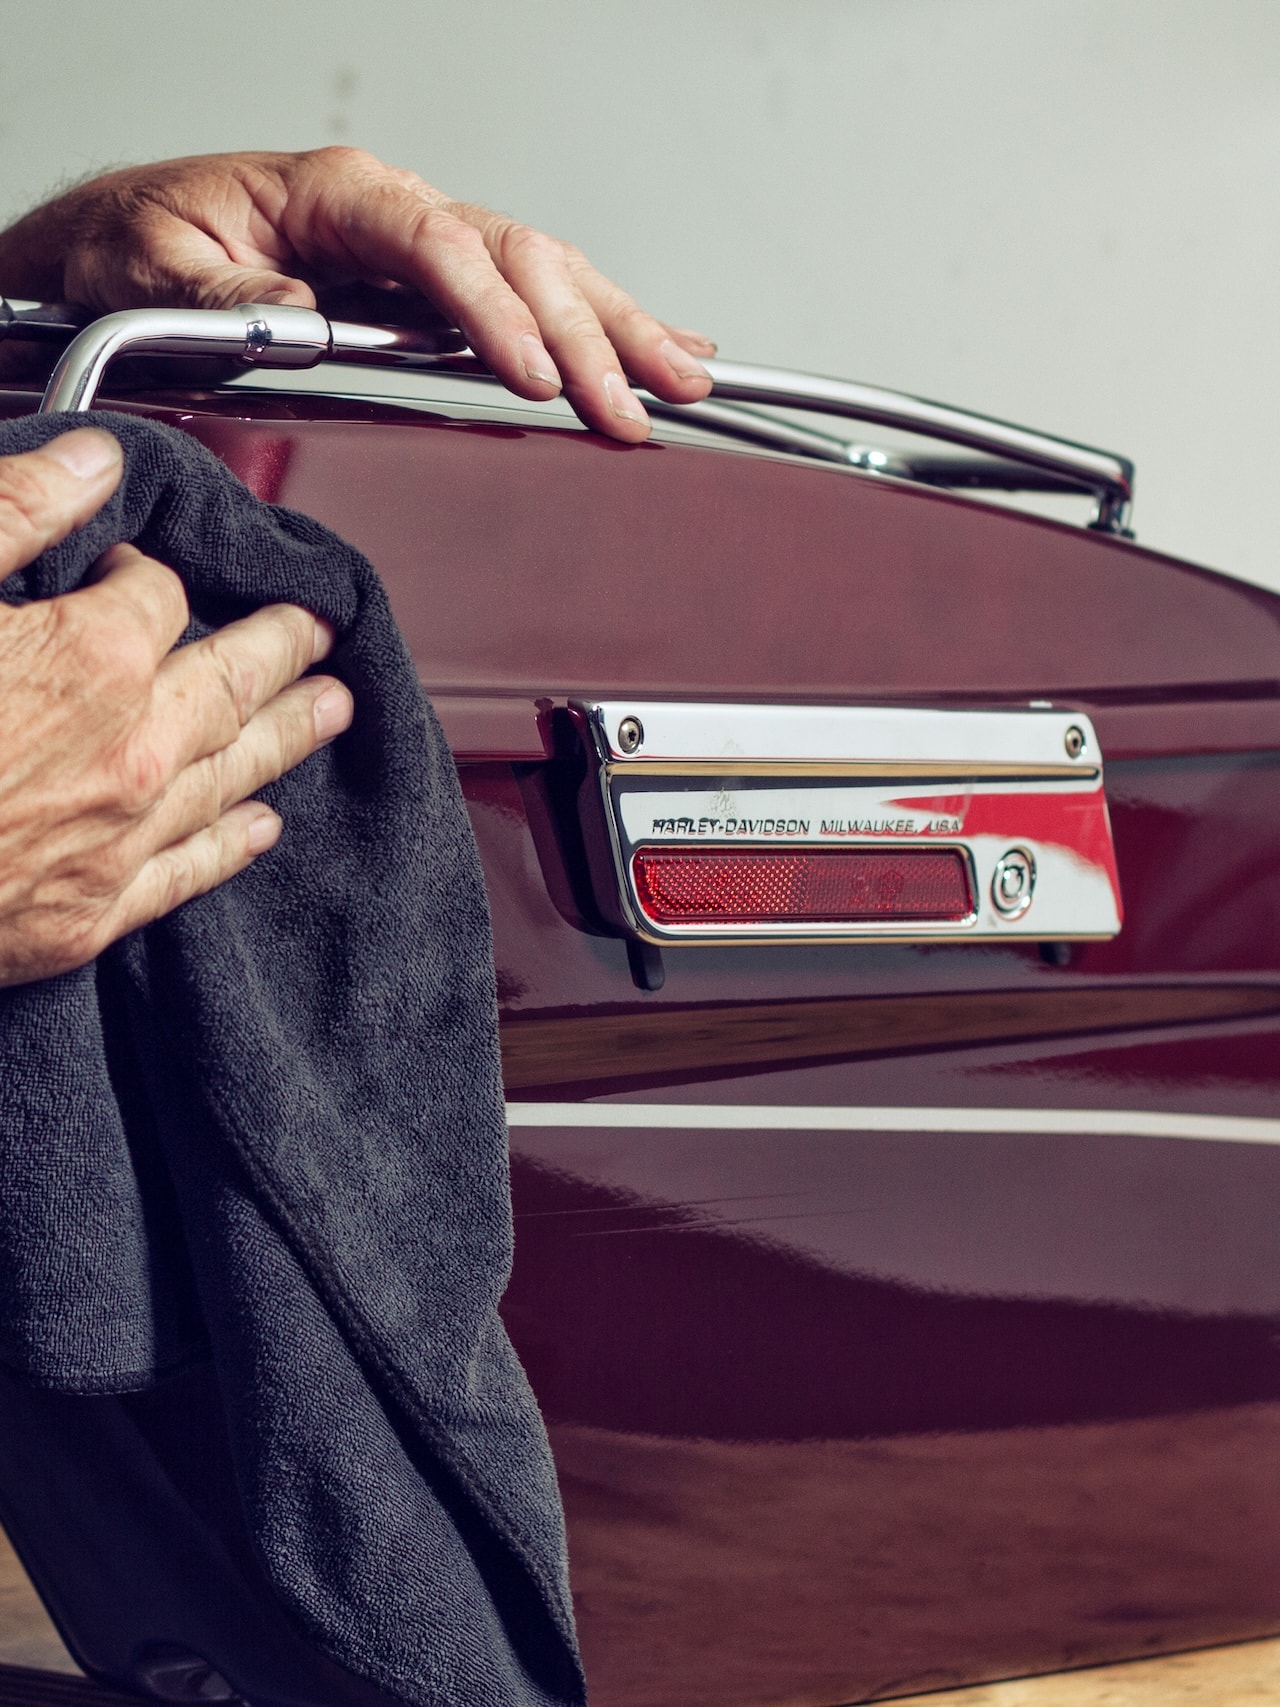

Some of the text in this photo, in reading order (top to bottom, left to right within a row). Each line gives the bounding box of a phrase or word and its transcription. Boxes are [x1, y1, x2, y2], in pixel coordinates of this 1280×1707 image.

[652, 817, 961, 835] HARLEY-DAVIDSON MILWAUKEE, USA
